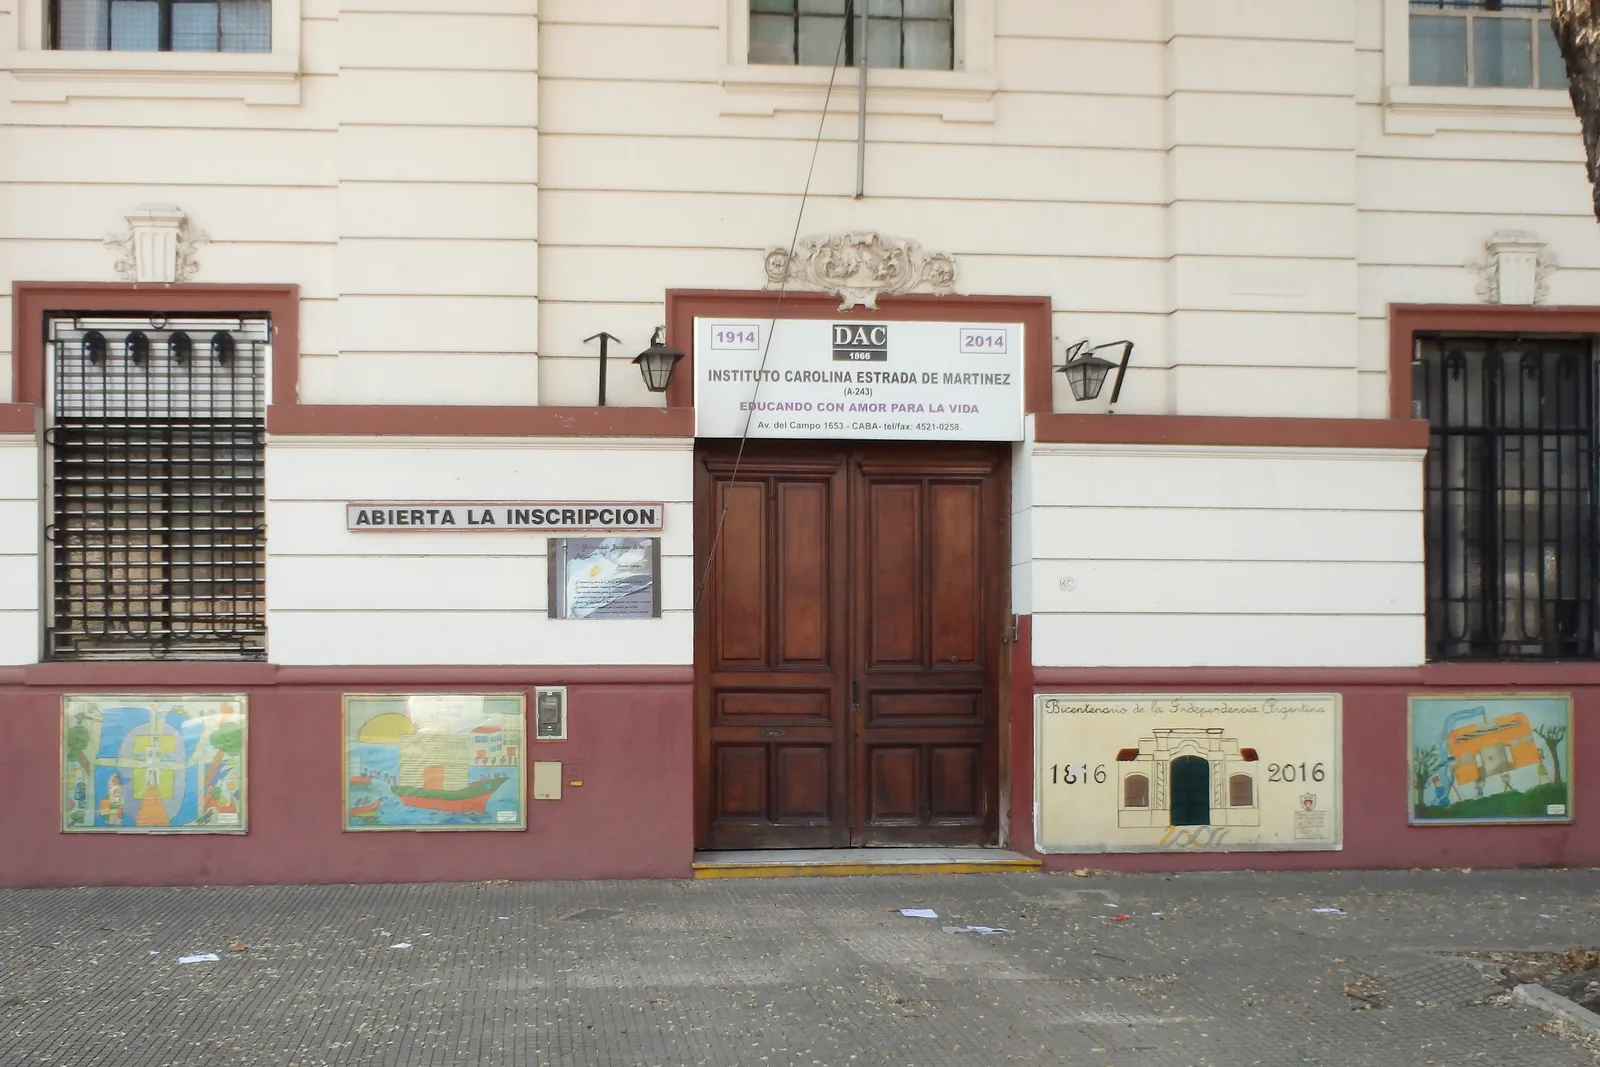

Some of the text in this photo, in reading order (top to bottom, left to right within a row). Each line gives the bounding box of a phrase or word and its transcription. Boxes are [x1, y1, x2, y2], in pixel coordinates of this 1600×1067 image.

[716, 331, 756, 344] 1914
[834, 326, 886, 345] DAC
[965, 335, 1004, 348] 2014
[849, 352, 871, 360] 1866
[708, 369, 1011, 386] INSTITUTO CAROLINA ESTRADA DE MARTINEZ
[843, 387, 873, 398] (A-243)
[739, 401, 980, 414] EDUCANDO CON AMOR PARA LA VIDA
[757, 421, 771, 429] Av.
[773, 421, 787, 430] del
[789, 421, 821, 431] Campo
[823, 422, 844, 430] 1653
[356, 508, 655, 526] ABIERTA LA INSCRIPCION
[1045, 697, 1326, 719] Bicentenario de la Independencia Argentina
[1050, 763, 1107, 785] 1816
[1267, 762, 1326, 783] 2016
